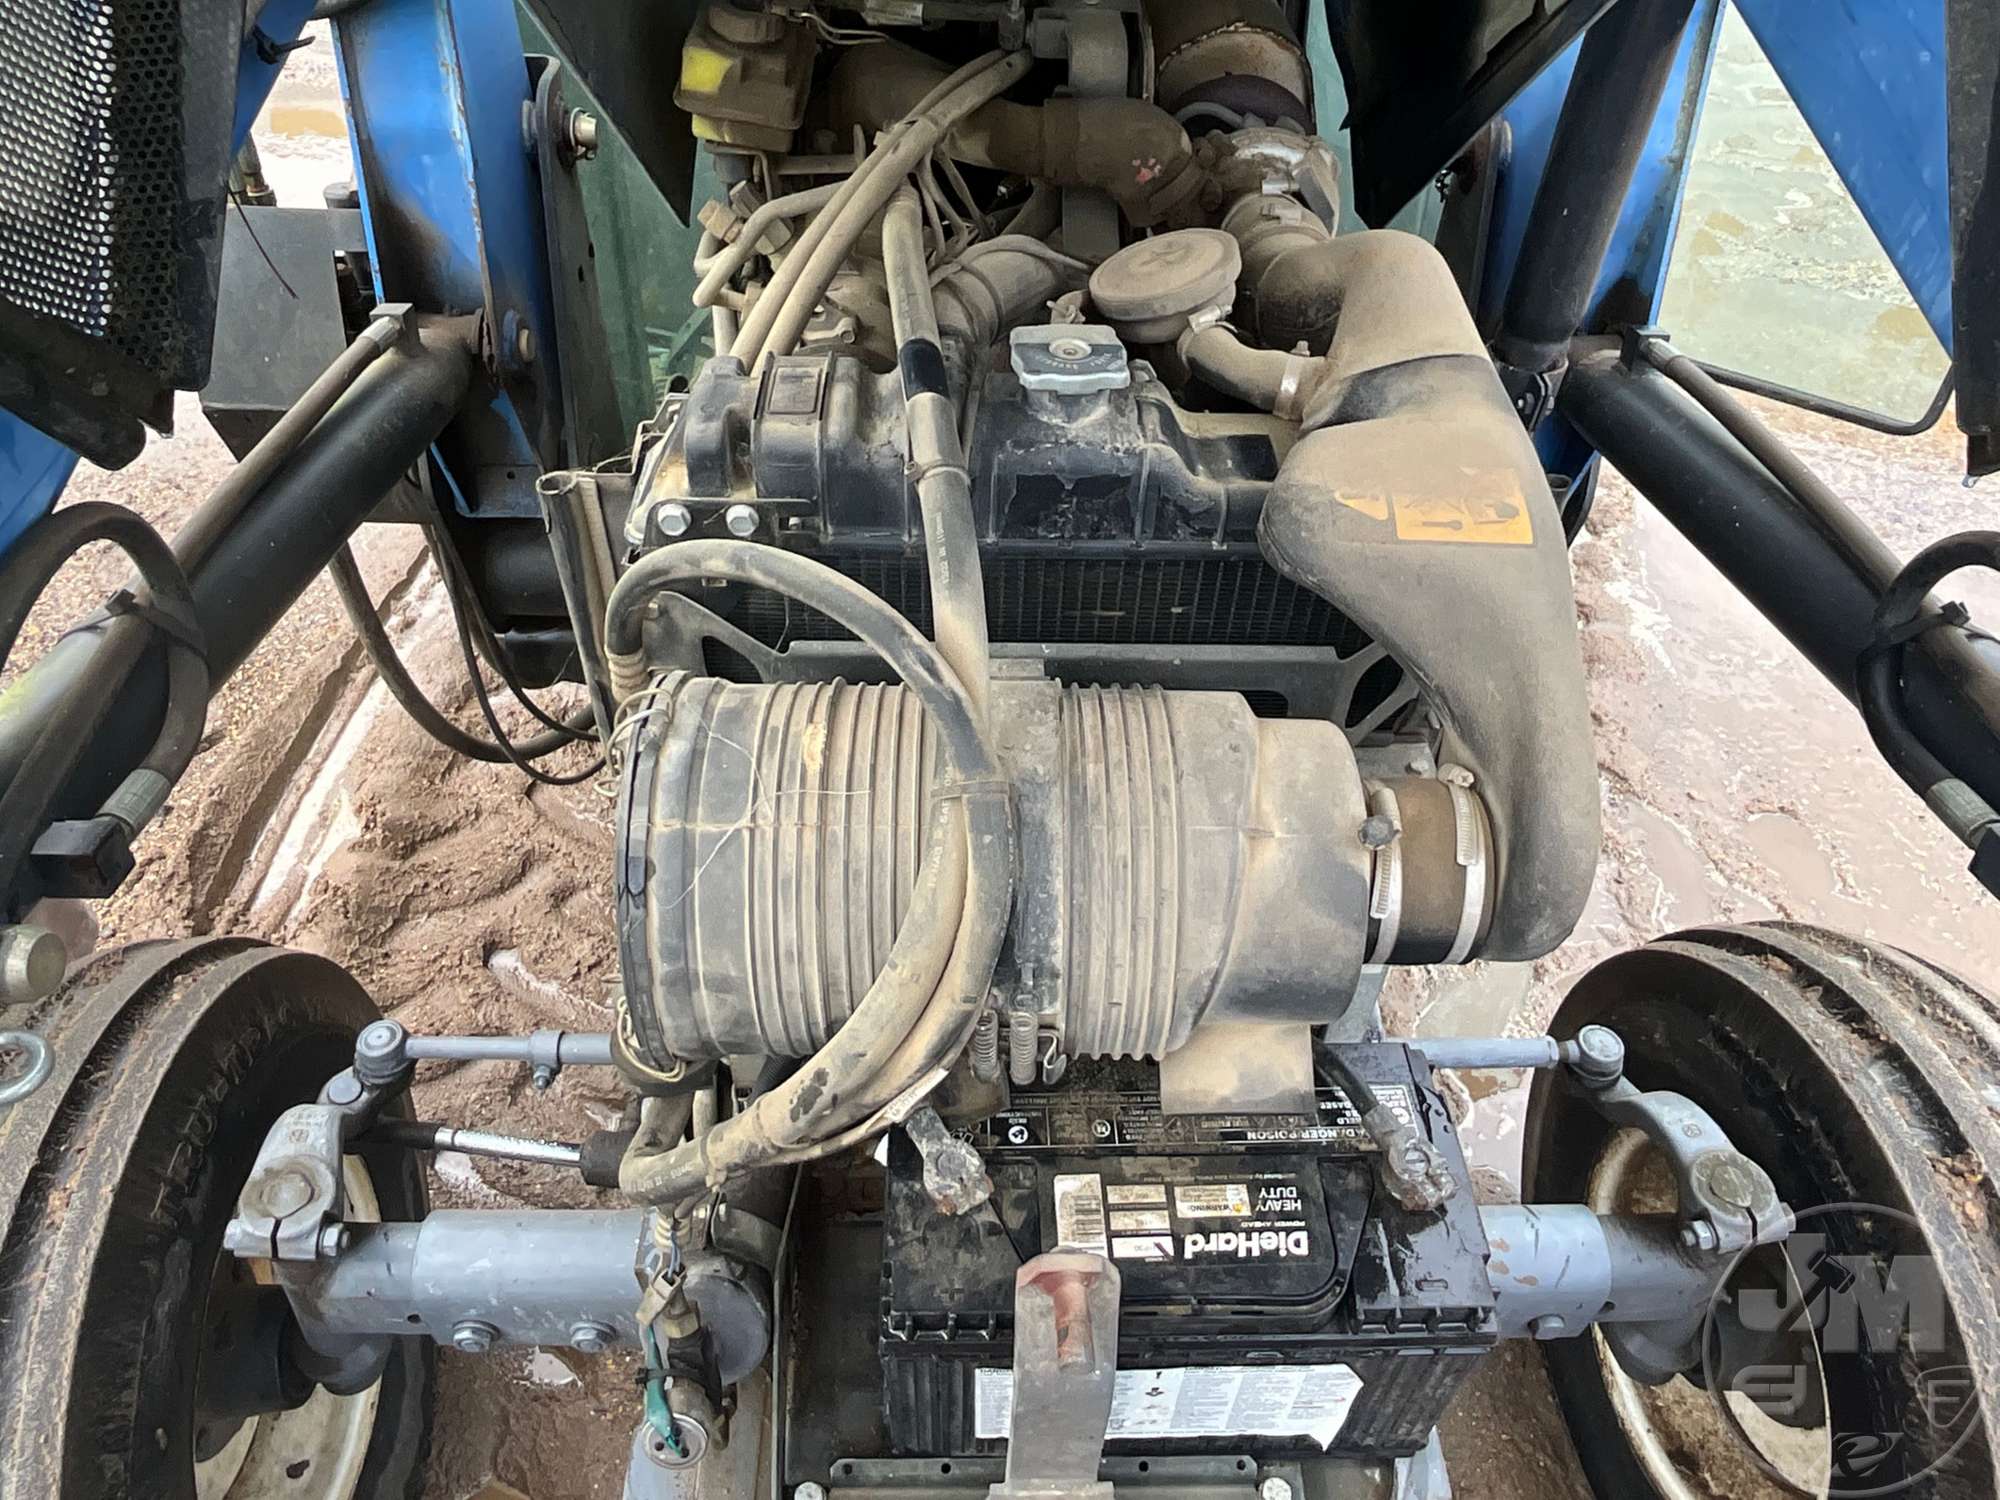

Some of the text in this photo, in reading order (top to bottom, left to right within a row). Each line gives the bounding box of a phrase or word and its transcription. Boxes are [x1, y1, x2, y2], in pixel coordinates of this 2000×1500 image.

[1258, 1186, 1298, 1199] DUTY
[1254, 1198, 1303, 1212] HEAVY
[1240, 1220, 1306, 1229] POWER AHEAD
[1184, 1230, 1309, 1258] DieHard
